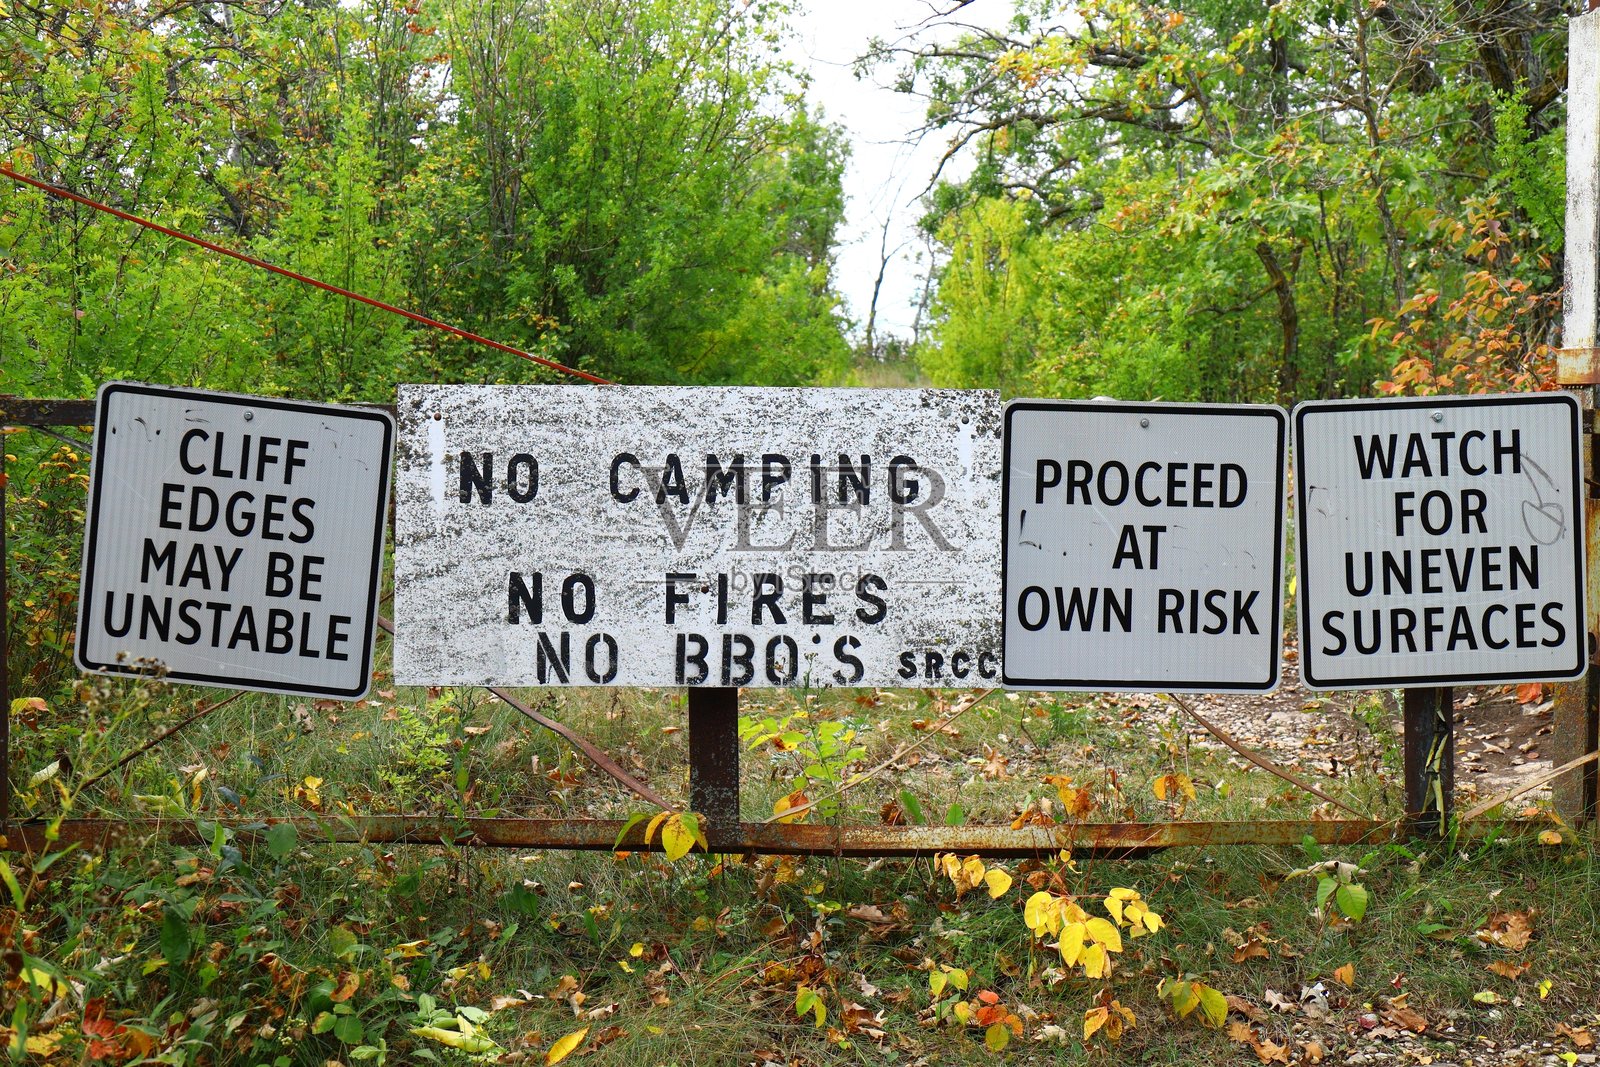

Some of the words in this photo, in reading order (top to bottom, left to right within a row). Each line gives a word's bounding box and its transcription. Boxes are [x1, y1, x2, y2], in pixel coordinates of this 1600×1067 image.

[179, 428, 309, 484] CLIFF
[459, 452, 539, 504] NO
[609, 452, 919, 505] CAMPING
[1354, 429, 1522, 480] WATCH
[1035, 459, 1248, 508] PROCEED
[159, 483, 316, 544] EDGES
[1394, 489, 1488, 537] FOR
[140, 538, 244, 592] MAY
[265, 552, 325, 602] BE
[1112, 525, 1167, 570] AT
[1345, 545, 1540, 597] UNEVEN
[508, 572, 596, 625] NO
[665, 572, 889, 625] FIRES
[1017, 586, 1133, 632] OWN
[1157, 589, 1260, 635] RISK
[103, 591, 352, 662] UNSTABLE
[1321, 602, 1567, 656] SURFACES
[536, 631, 619, 685] NO
[897, 651, 998, 679] SRCC
